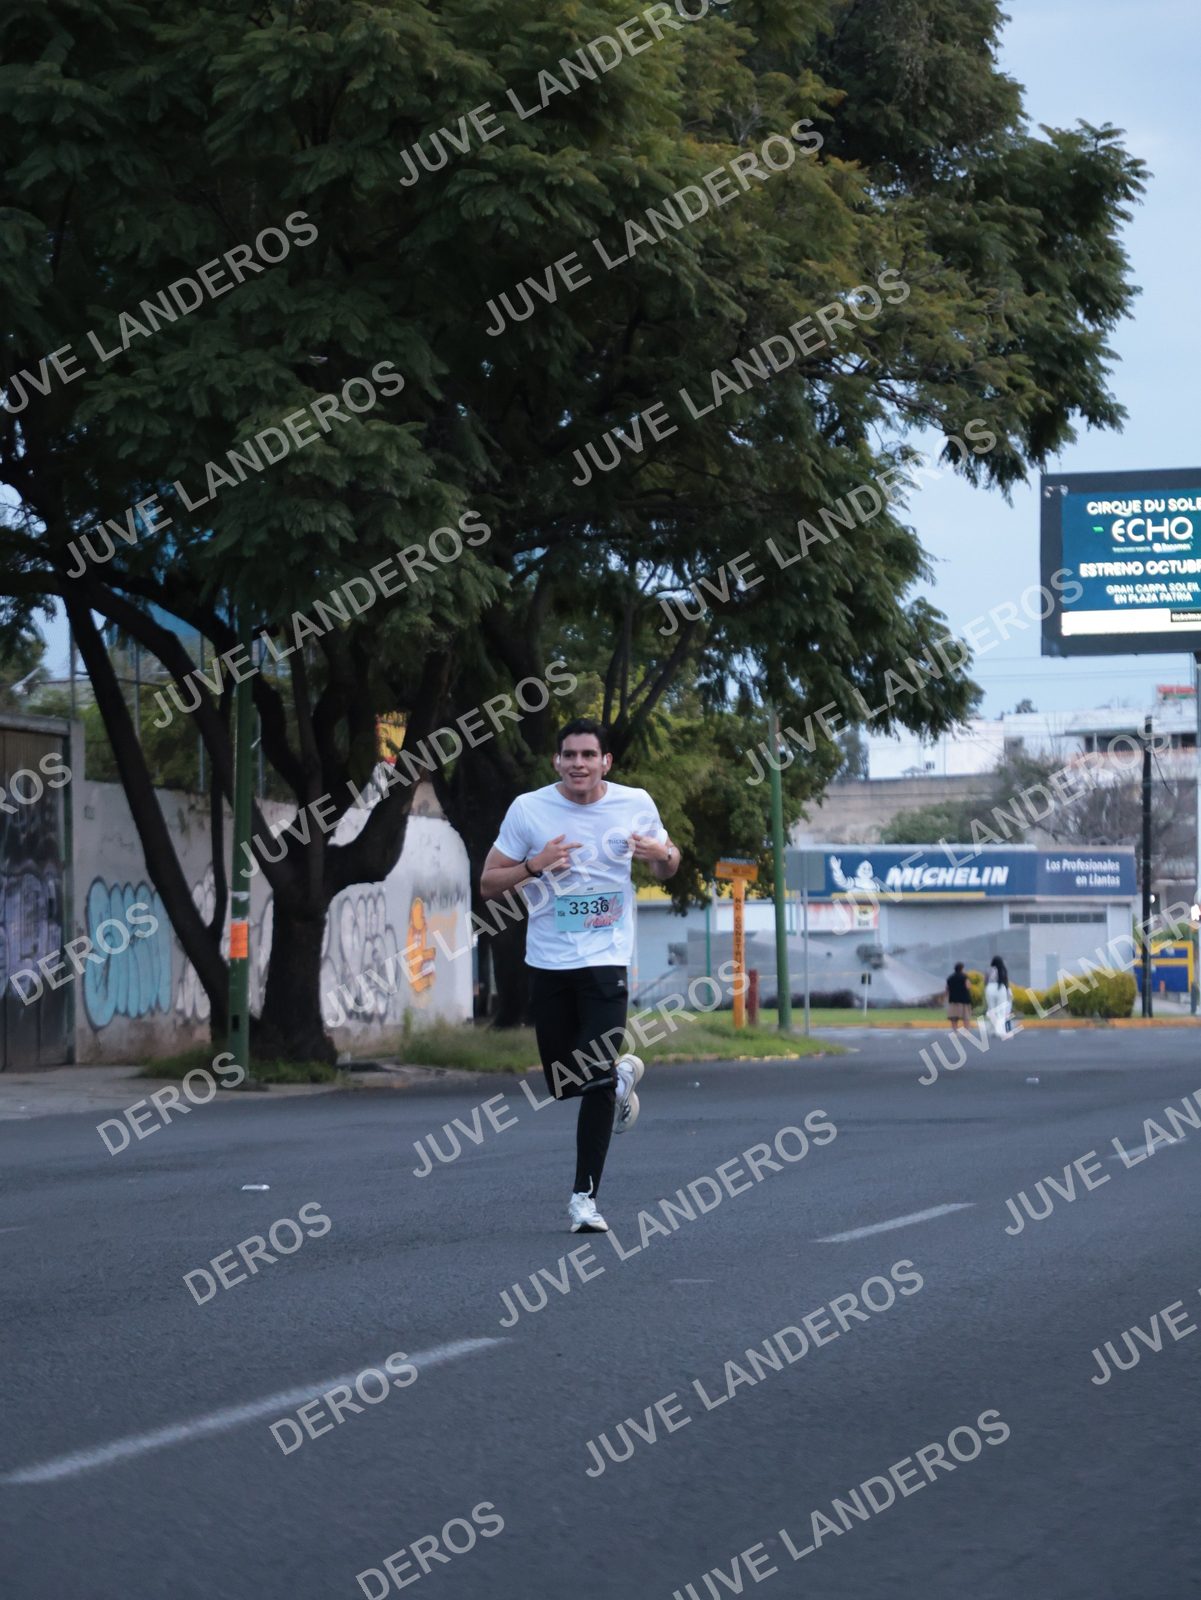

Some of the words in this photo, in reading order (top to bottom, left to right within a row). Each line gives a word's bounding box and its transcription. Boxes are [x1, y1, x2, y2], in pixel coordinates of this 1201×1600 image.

[1087, 500, 1142, 517] CIRQUE
[1144, 499, 1165, 513] DU
[1112, 516, 1193, 542] ECHO
[1080, 562, 1144, 577] ESTRENO
[1106, 585, 1134, 595] GRAN
[1135, 583, 1168, 594] CARPA
[1114, 594, 1127, 604] EN
[1128, 593, 1159, 603] PLAZA
[1046, 858, 1061, 872] Los
[1062, 860, 1120, 873] Profesionales
[886, 866, 1009, 886] MICHELIN
[1076, 875, 1087, 887] en
[1089, 873, 1120, 887] Llantas
[569, 899, 609, 915] 3336
